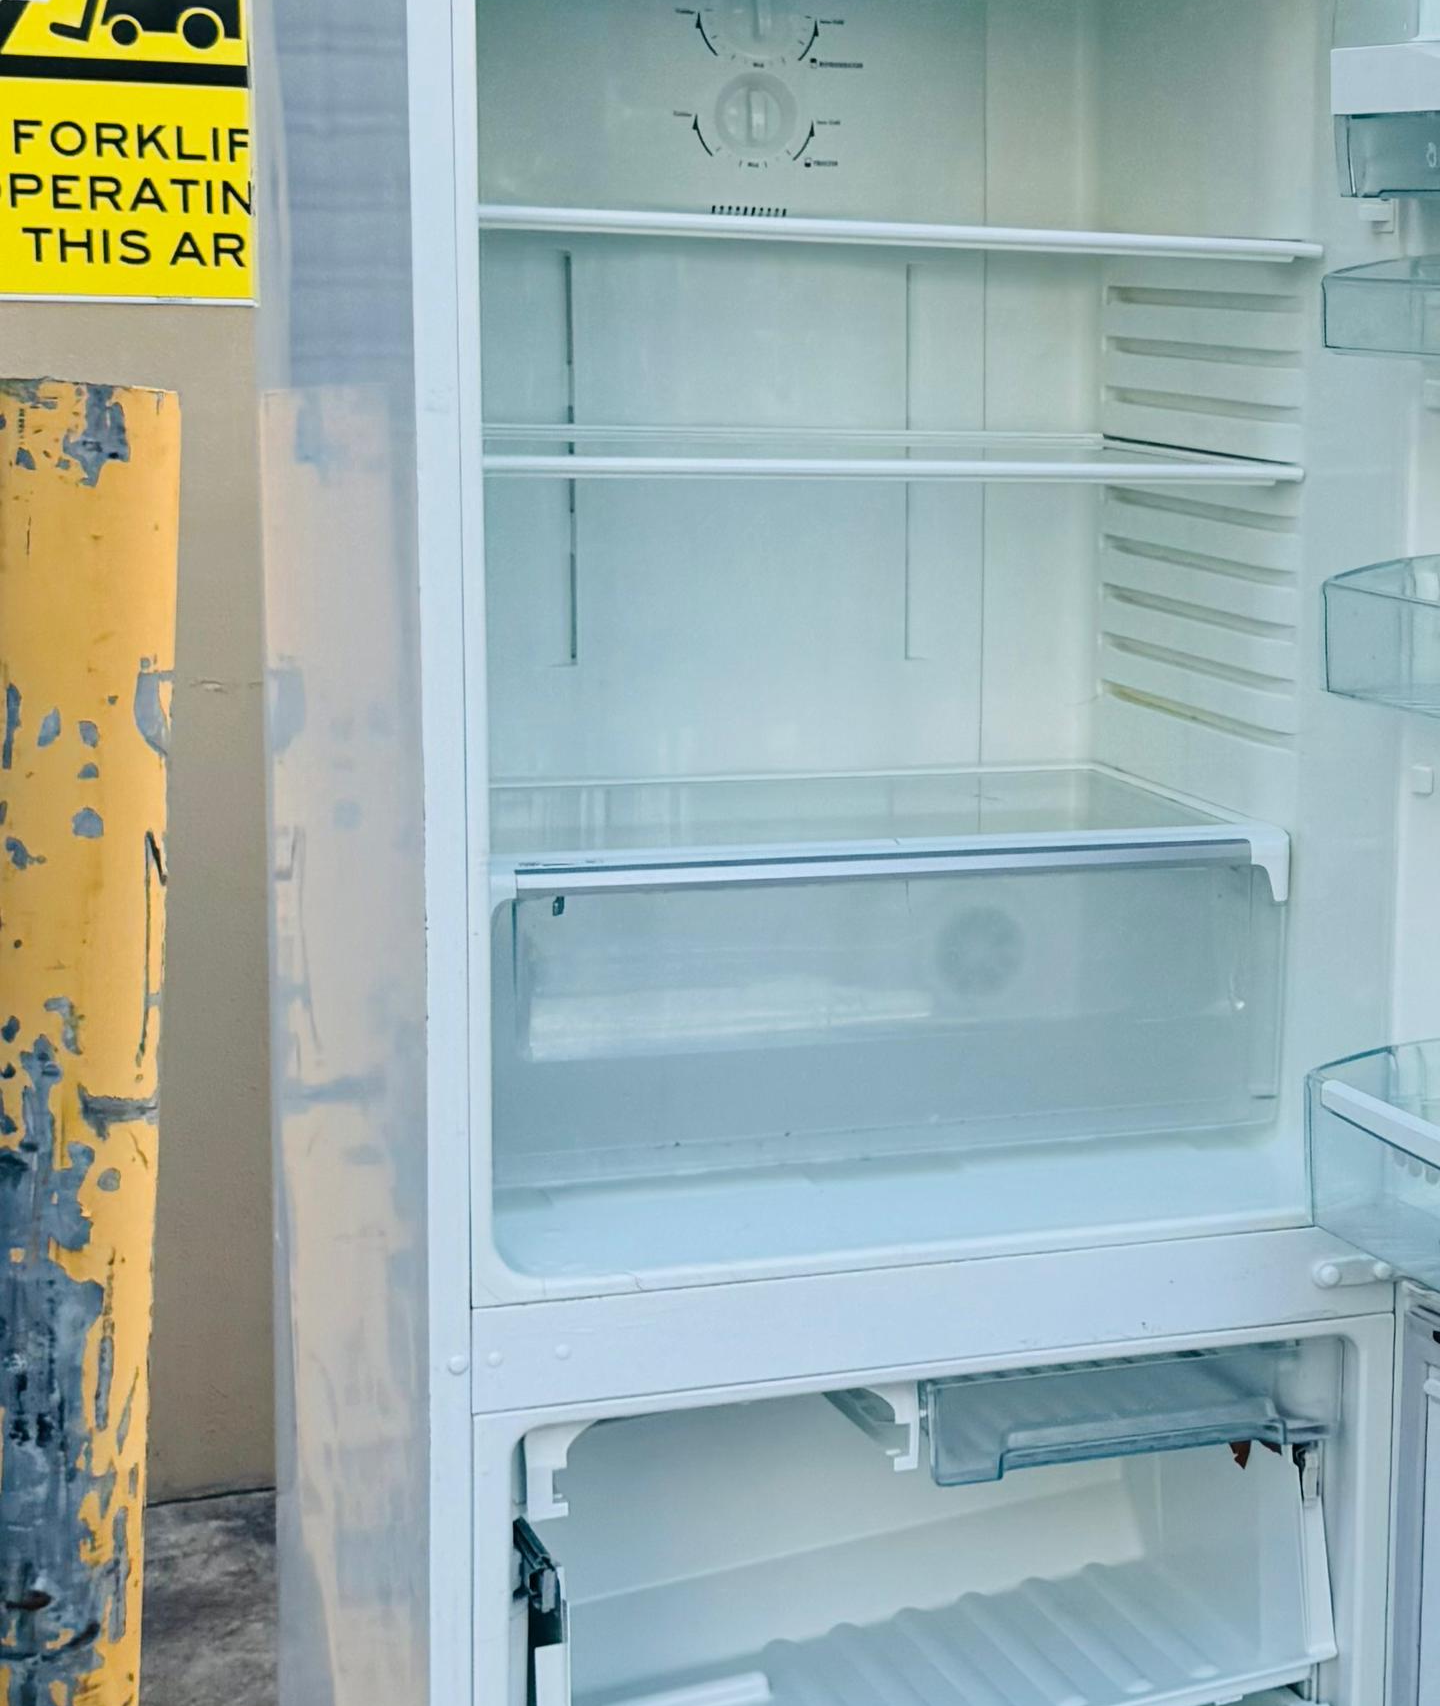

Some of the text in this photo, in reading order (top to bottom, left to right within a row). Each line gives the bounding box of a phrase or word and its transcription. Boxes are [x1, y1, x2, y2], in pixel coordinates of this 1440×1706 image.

[13, 119, 249, 162] FORKLIF
[0, 173, 252, 215] PERATIN
[22, 227, 246, 267] THIS AR
